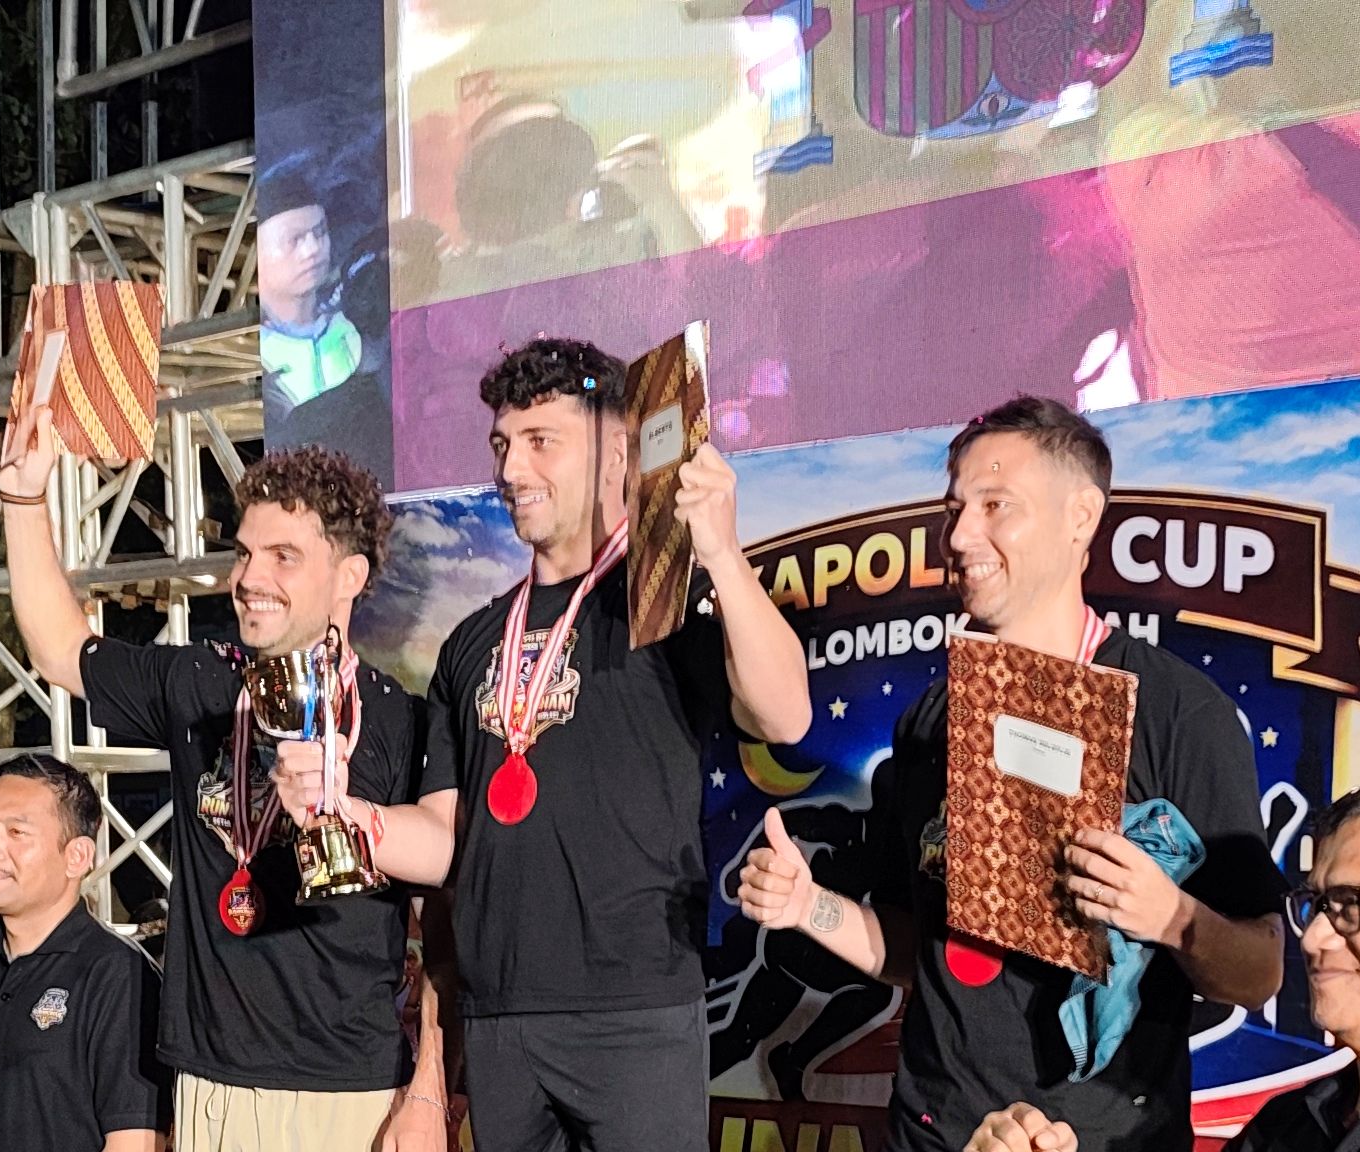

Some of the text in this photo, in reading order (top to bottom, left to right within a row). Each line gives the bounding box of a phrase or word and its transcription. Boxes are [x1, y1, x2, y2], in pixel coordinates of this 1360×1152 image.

[752, 515, 1276, 610] APOL CUP
[808, 612, 972, 671] LOMBOK
